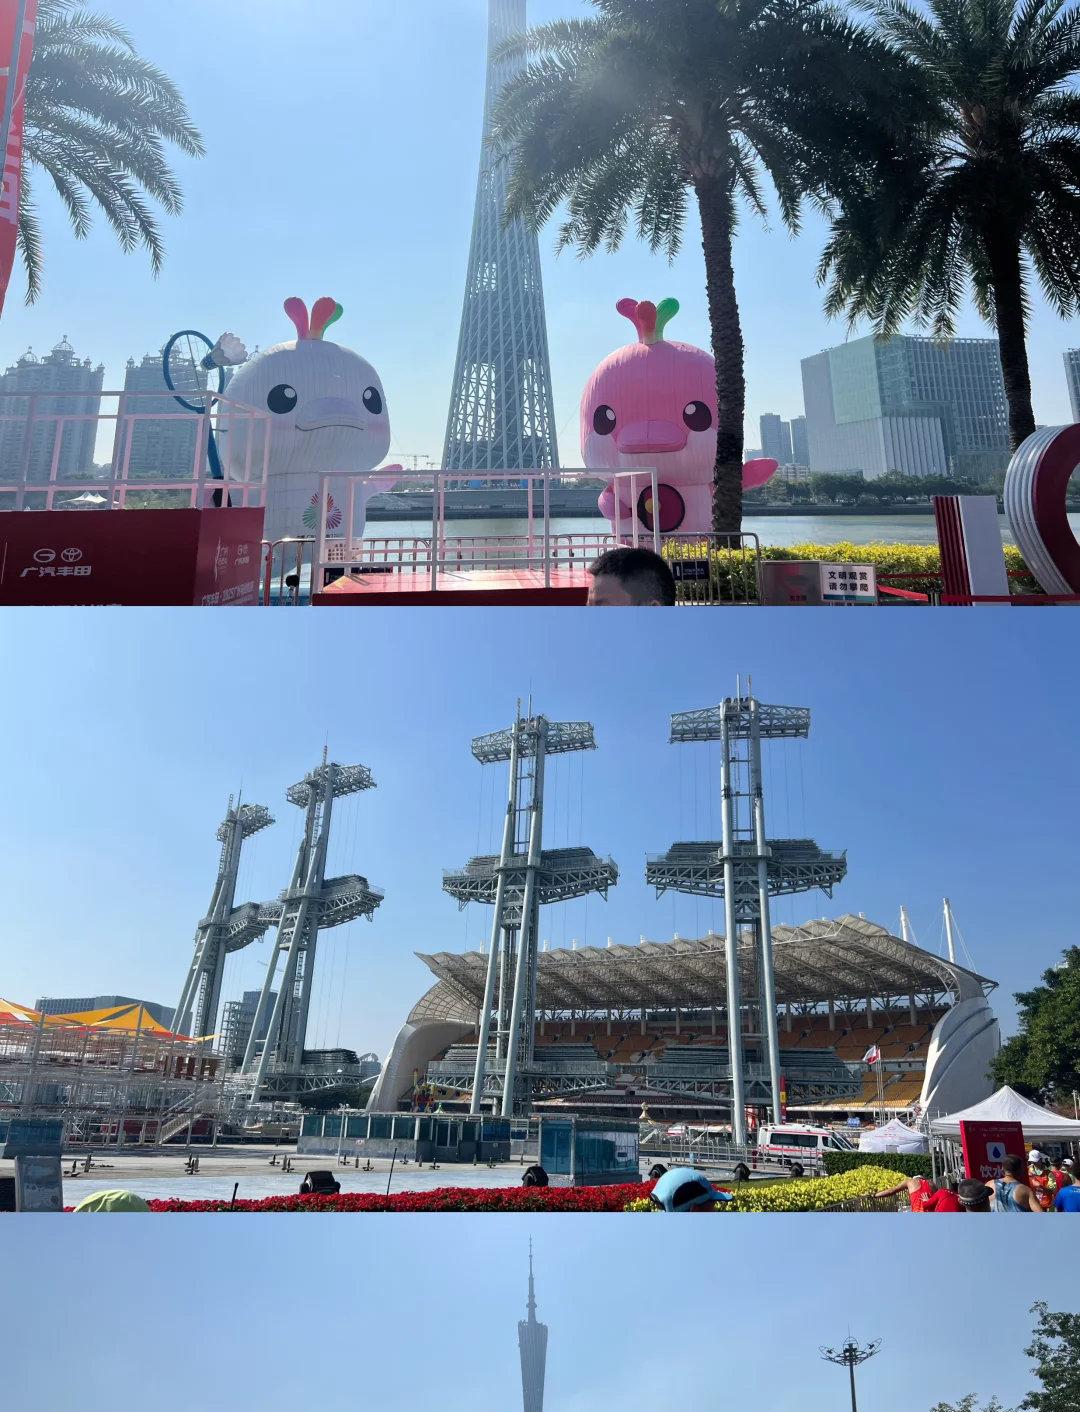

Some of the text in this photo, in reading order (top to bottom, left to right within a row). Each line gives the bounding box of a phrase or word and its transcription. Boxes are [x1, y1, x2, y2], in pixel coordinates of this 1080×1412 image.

[20, 566, 91, 577] 广汽丰田
[828, 571, 868, 580] 文明观赏
[829, 582, 869, 592] 请勿攀爬
